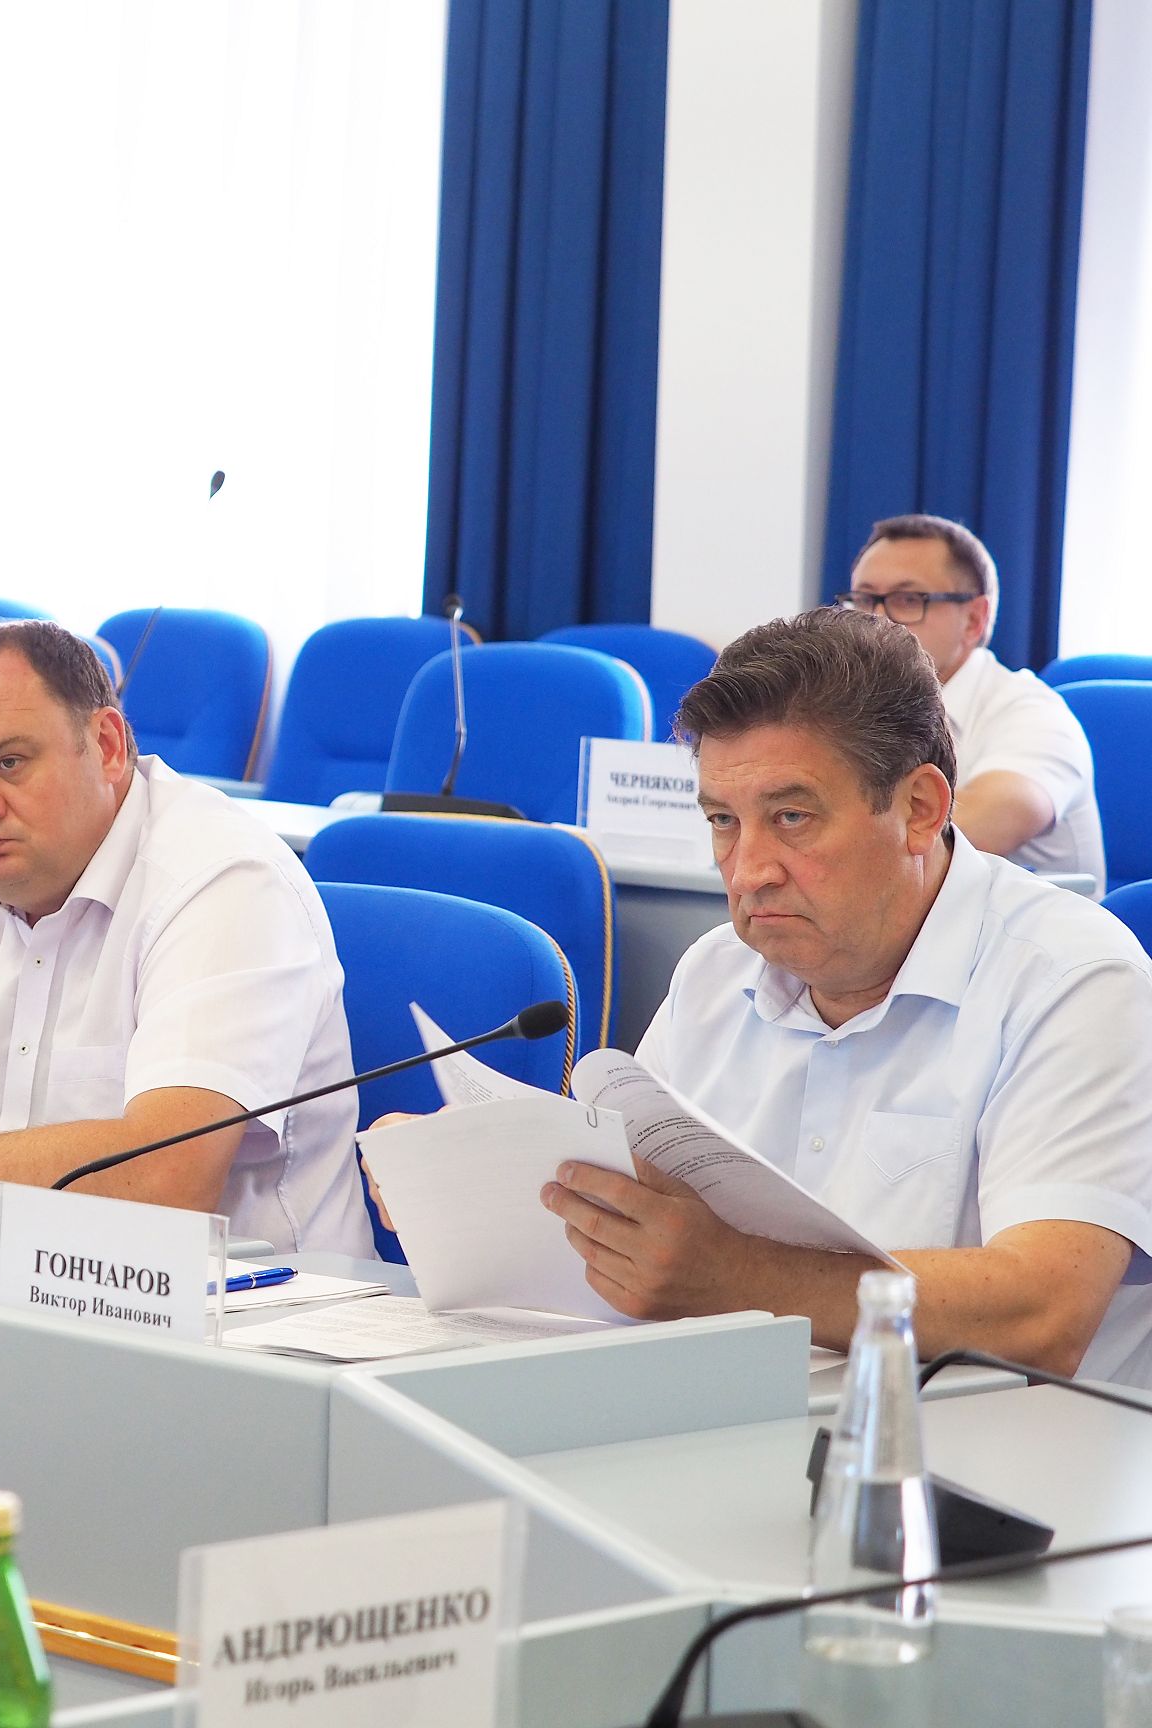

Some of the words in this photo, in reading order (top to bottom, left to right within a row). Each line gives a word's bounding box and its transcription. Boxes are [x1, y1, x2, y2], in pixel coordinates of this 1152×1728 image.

[610, 771, 695, 793] ЧЕРНЯКОВ
[34, 1249, 171, 1297] ГОНЧАРОВ
[30, 1285, 87, 1316] Виктор
[92, 1297, 172, 1328] Иванович
[213, 1588, 491, 1668] АНДРЮЩЕНКО
[245, 1676, 316, 1706] Игорь
[323, 1651, 458, 1692] Васильевич
